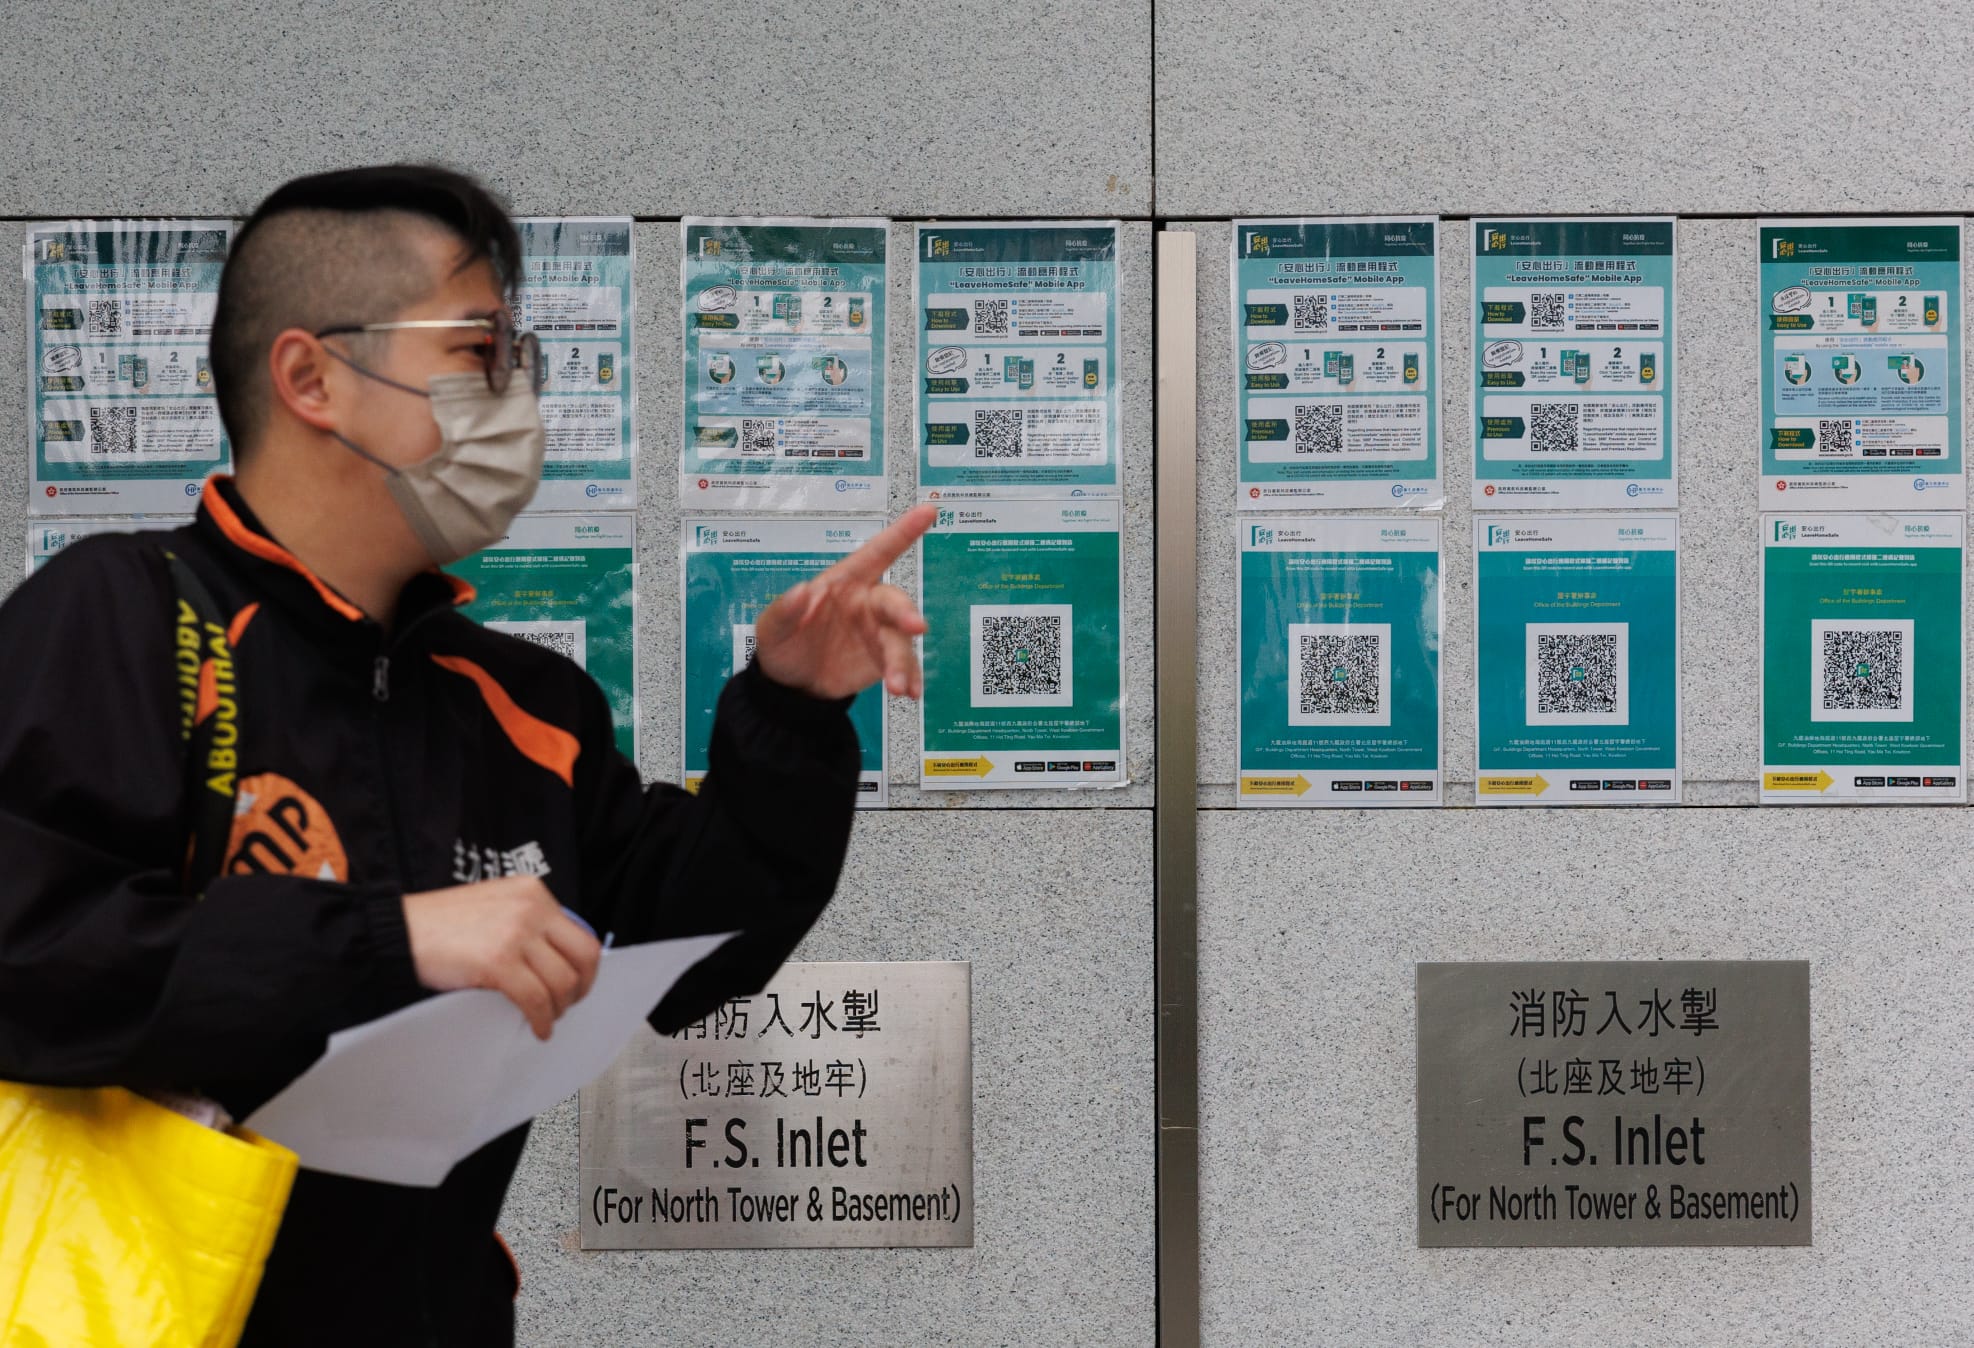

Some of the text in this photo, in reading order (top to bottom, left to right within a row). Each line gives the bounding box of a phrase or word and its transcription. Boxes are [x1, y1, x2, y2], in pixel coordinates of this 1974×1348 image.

[581, 274, 599, 283] App
[1353, 275, 1384, 283] Mobile
[1385, 275, 1404, 284] App
[1591, 274, 1621, 282] Mobile
[1623, 274, 1642, 283] App
[1904, 279, 1920, 287] App
[1034, 280, 1064, 288] Mobile
[1066, 280, 1084, 289] App
[754, 296, 759, 306] 1
[824, 297, 832, 308] 2
[1828, 297, 1834, 307] 1
[1899, 296, 1907, 306] 2
[98, 352, 104, 363] 1
[170, 351, 178, 362] 2
[571, 347, 579, 358] 2
[1304, 349, 1309, 360] 1
[1376, 347, 1384, 359] 2
[1540, 347, 1546, 358] 1
[1613, 347, 1621, 358] 2
[984, 353, 990, 364] 1
[1057, 353, 1065, 364] 2
[1509, 987, 1720, 1038] 消防入水掣
[679, 1058, 867, 1100] (北座及地牢)
[1517, 1056, 1705, 1098] (北座及地牢)
[685, 1116, 867, 1169] F.S. Inlet
[1523, 1114, 1706, 1167] F.S. Inlet
[593, 1183, 961, 1227] (For North Tower & Basement)
[1430, 1181, 1799, 1224] (For North Tower & Basement)
